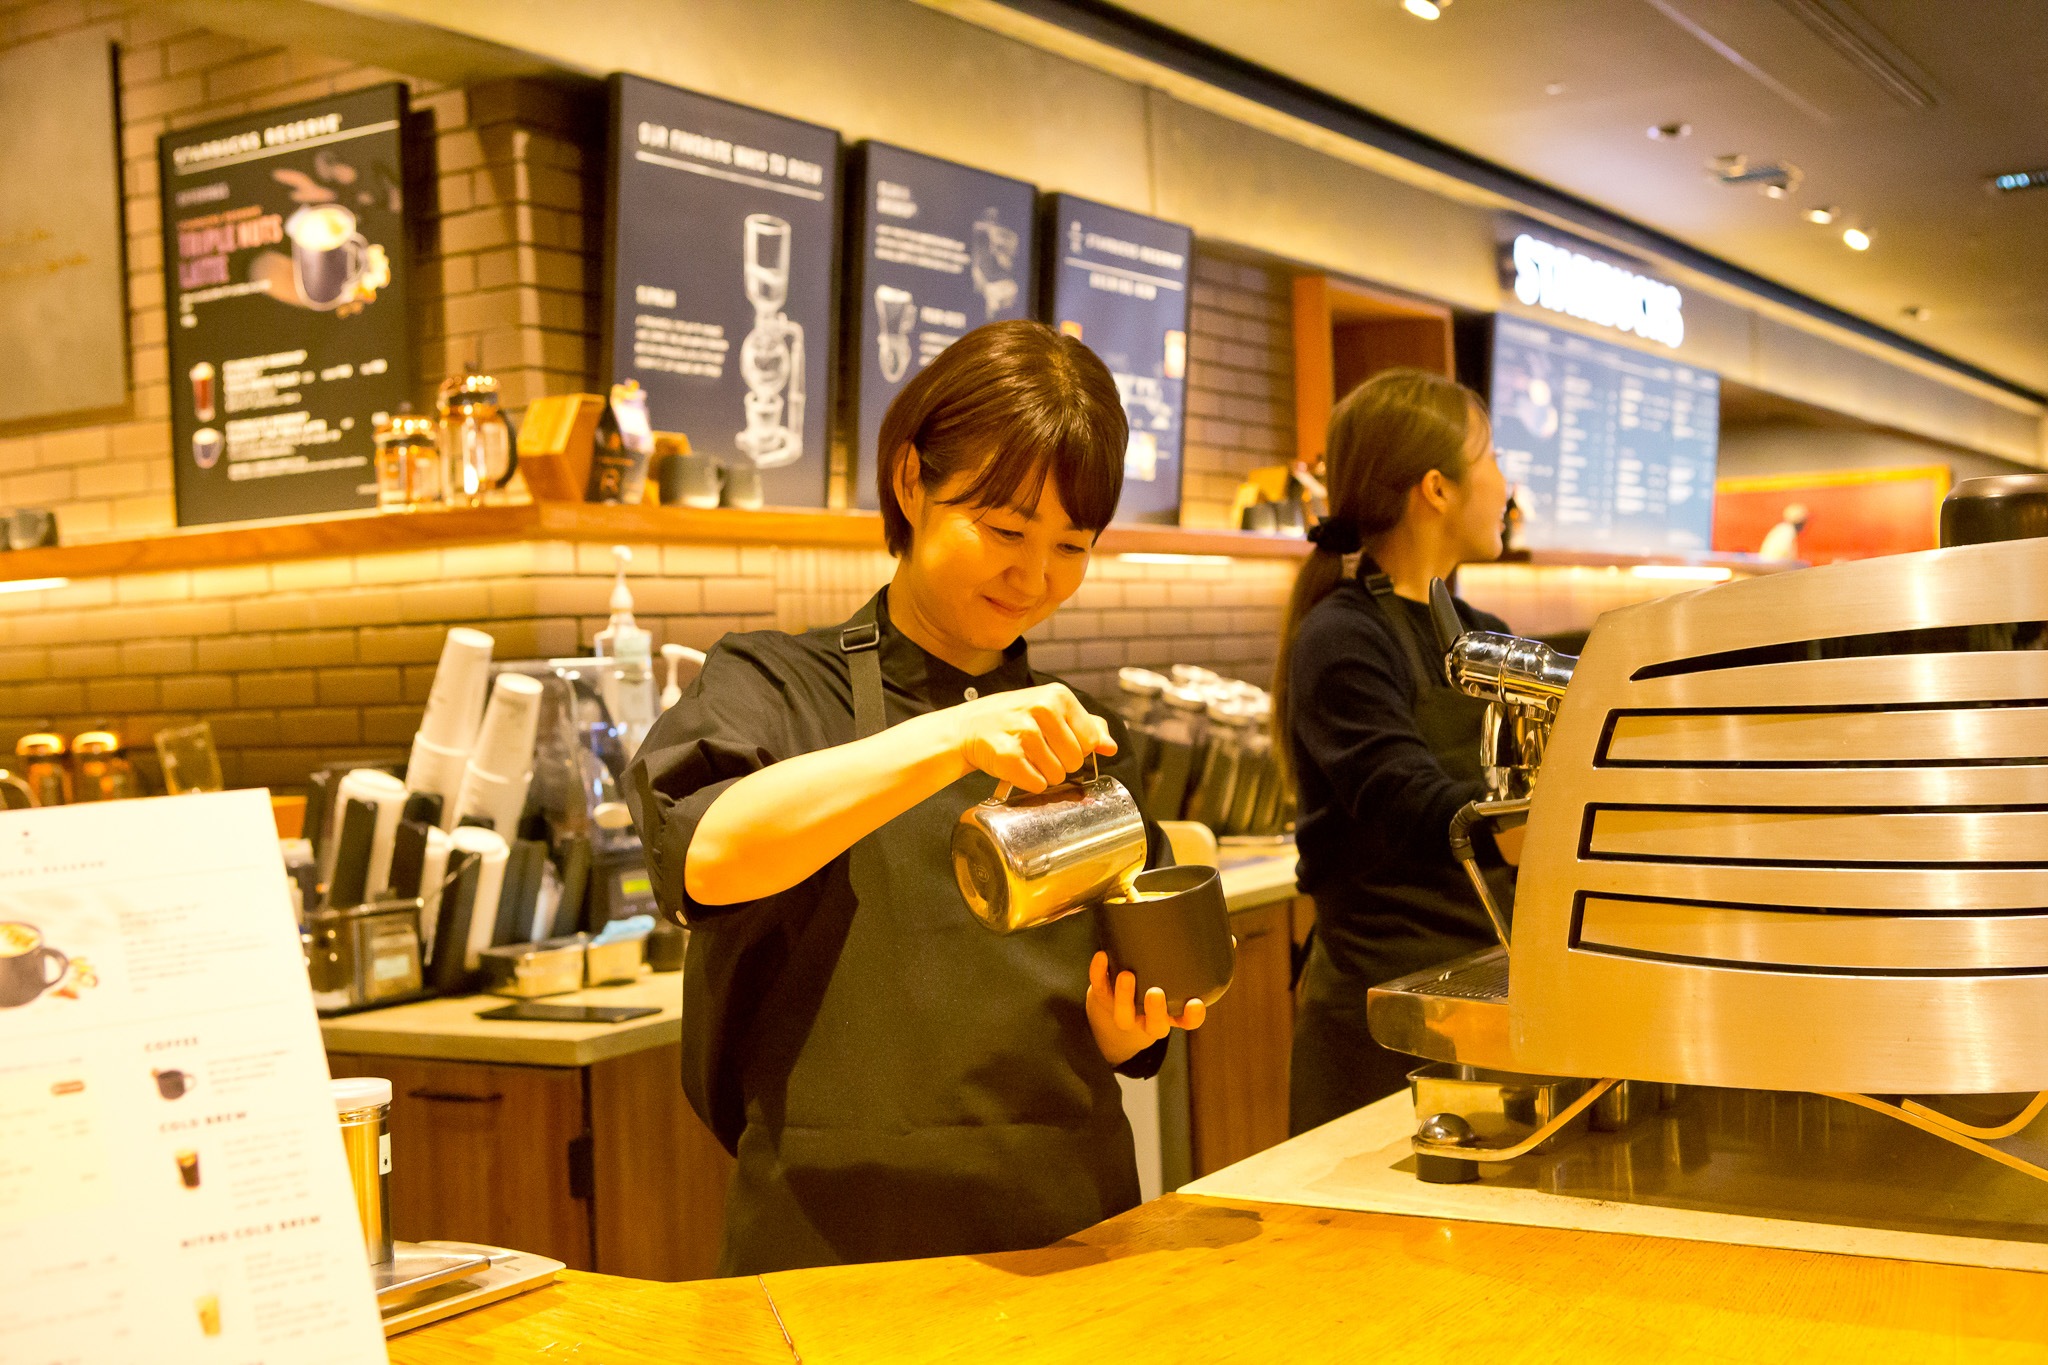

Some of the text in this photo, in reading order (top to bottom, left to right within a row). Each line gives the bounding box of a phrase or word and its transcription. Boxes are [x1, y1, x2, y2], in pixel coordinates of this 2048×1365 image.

[144, 1036, 199, 1054] COFFEE
[159, 1109, 248, 1134] COLD BREW
[179, 1213, 322, 1249] NITRO COLD BREW
